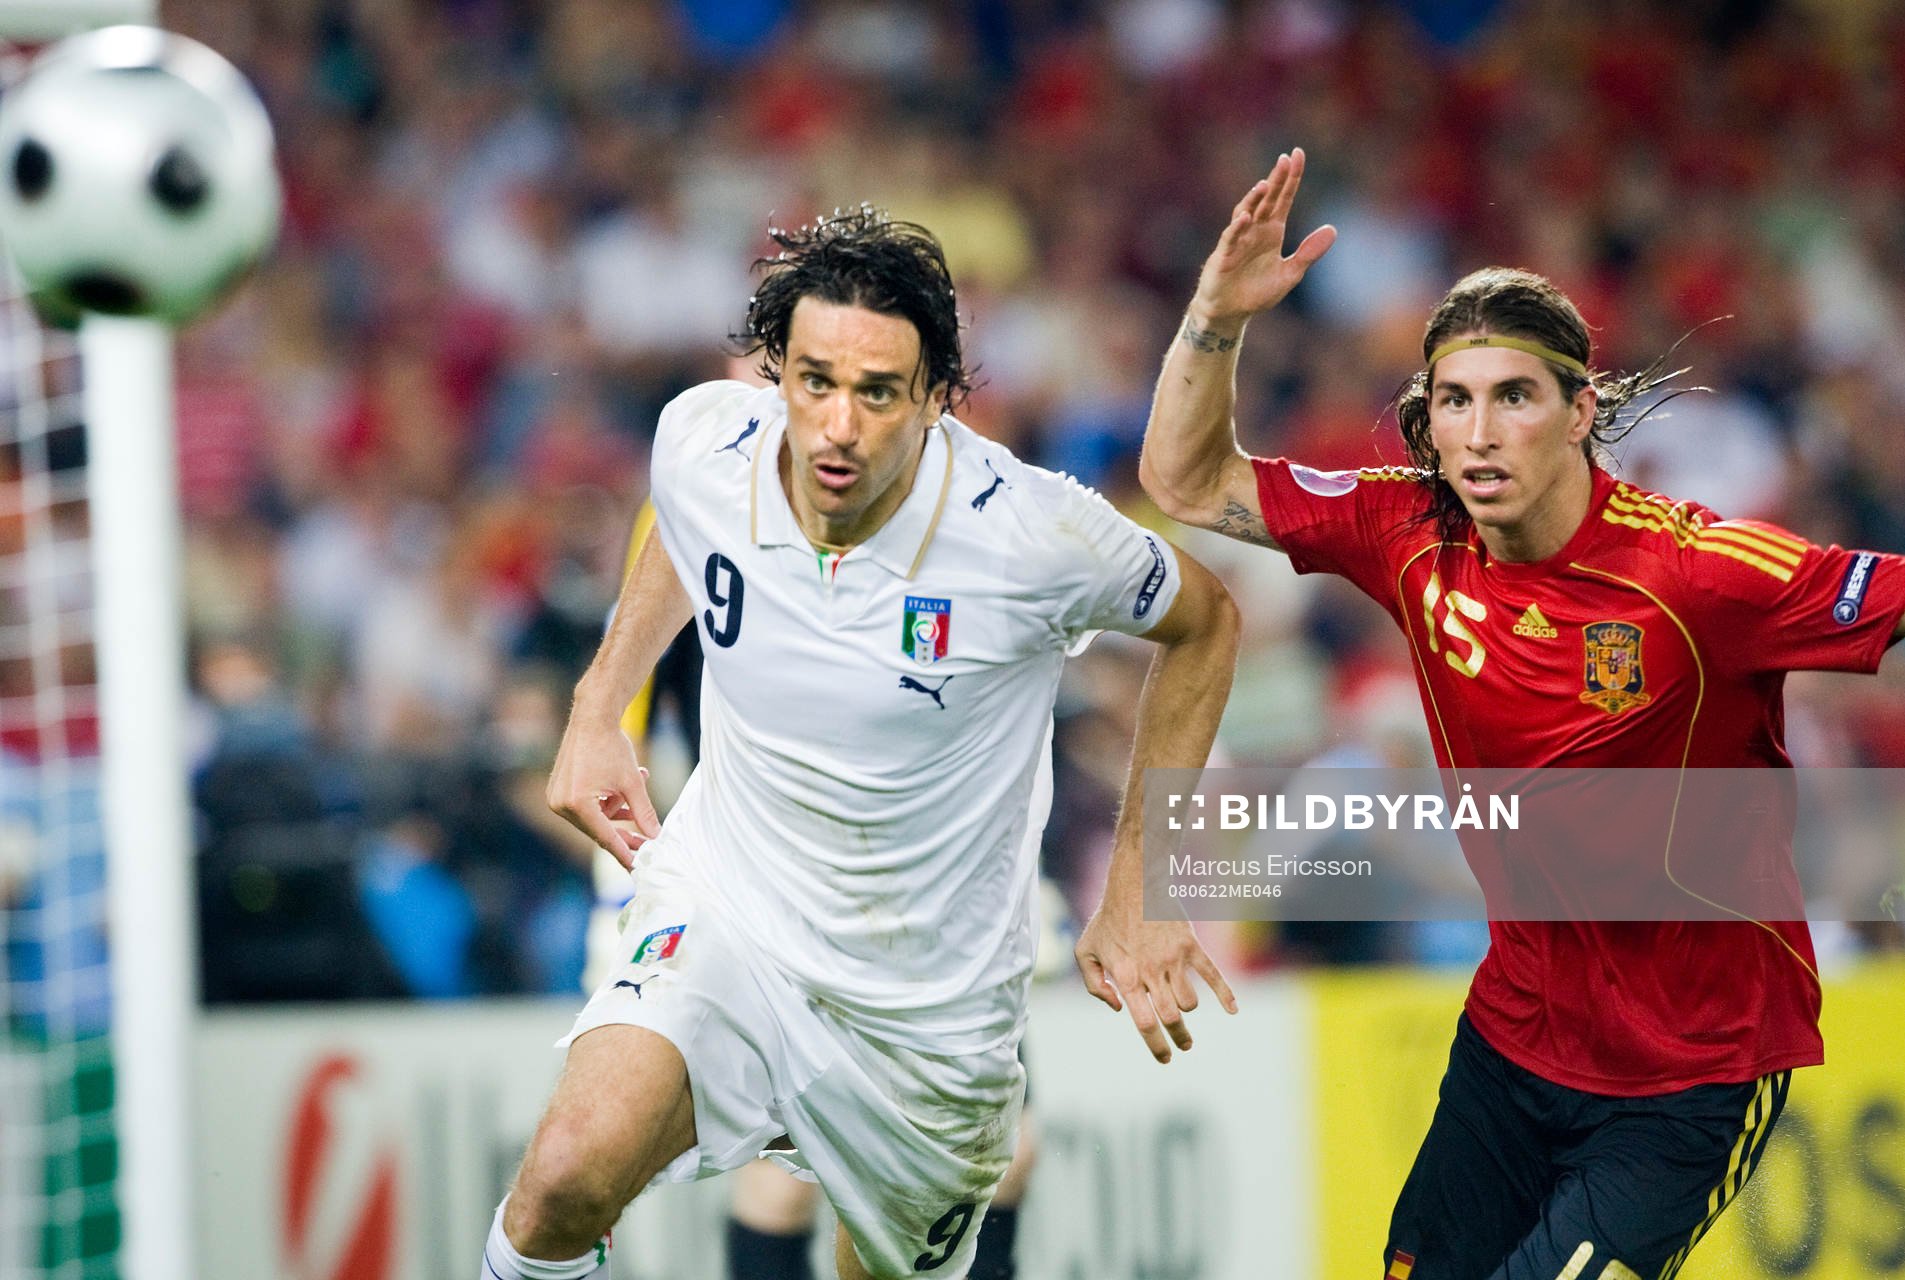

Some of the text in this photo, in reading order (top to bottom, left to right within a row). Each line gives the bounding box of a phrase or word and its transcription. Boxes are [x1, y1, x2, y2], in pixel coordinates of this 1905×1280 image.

[1469, 337, 1489, 346] NIKE
[1843, 551, 1874, 599] RESPEC
[704, 552, 745, 648] 9
[907, 600, 946, 612] ITALIA
[1422, 571, 1488, 679] 15
[1512, 623, 1558, 638] adidas
[914, 1202, 977, 1272] 9
